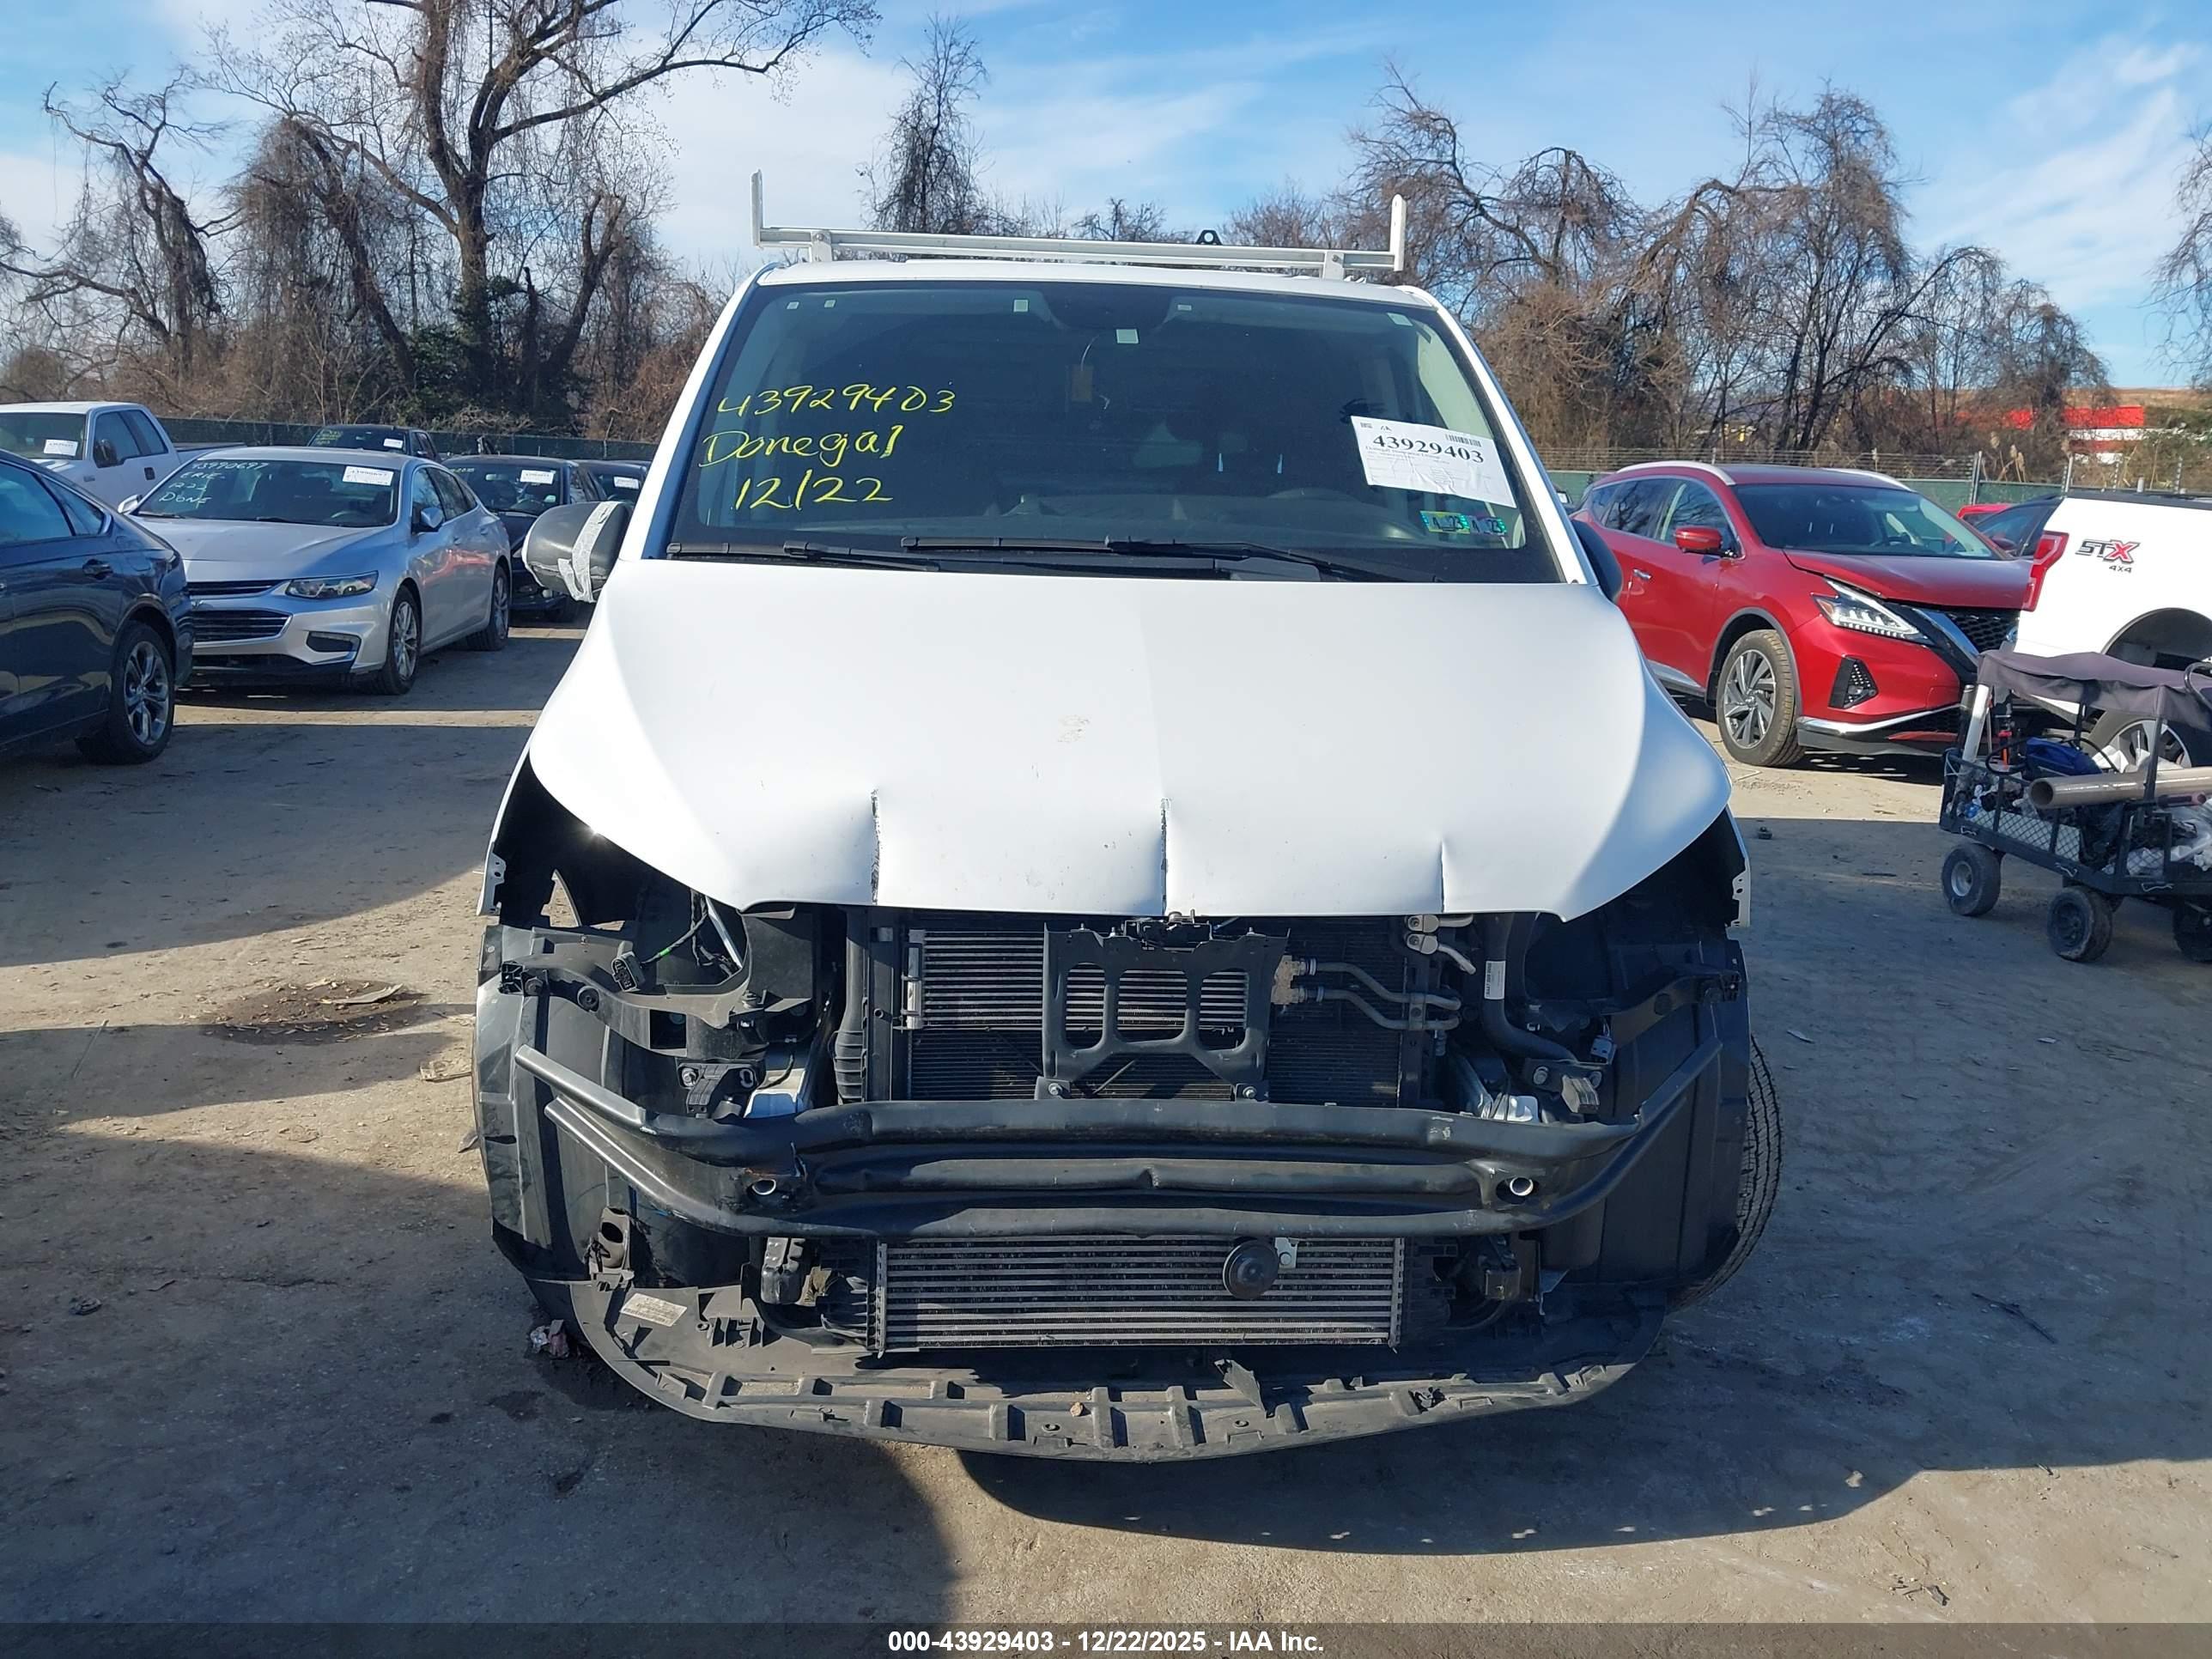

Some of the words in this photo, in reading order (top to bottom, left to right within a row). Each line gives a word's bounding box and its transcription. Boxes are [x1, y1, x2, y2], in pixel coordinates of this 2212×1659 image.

[717, 384, 957, 417] 43929403
[698, 424, 904, 467] Donegal
[1373, 434, 1484, 464] 43929403
[734, 469, 894, 511] 12/22
[2075, 538, 2141, 564] STX
